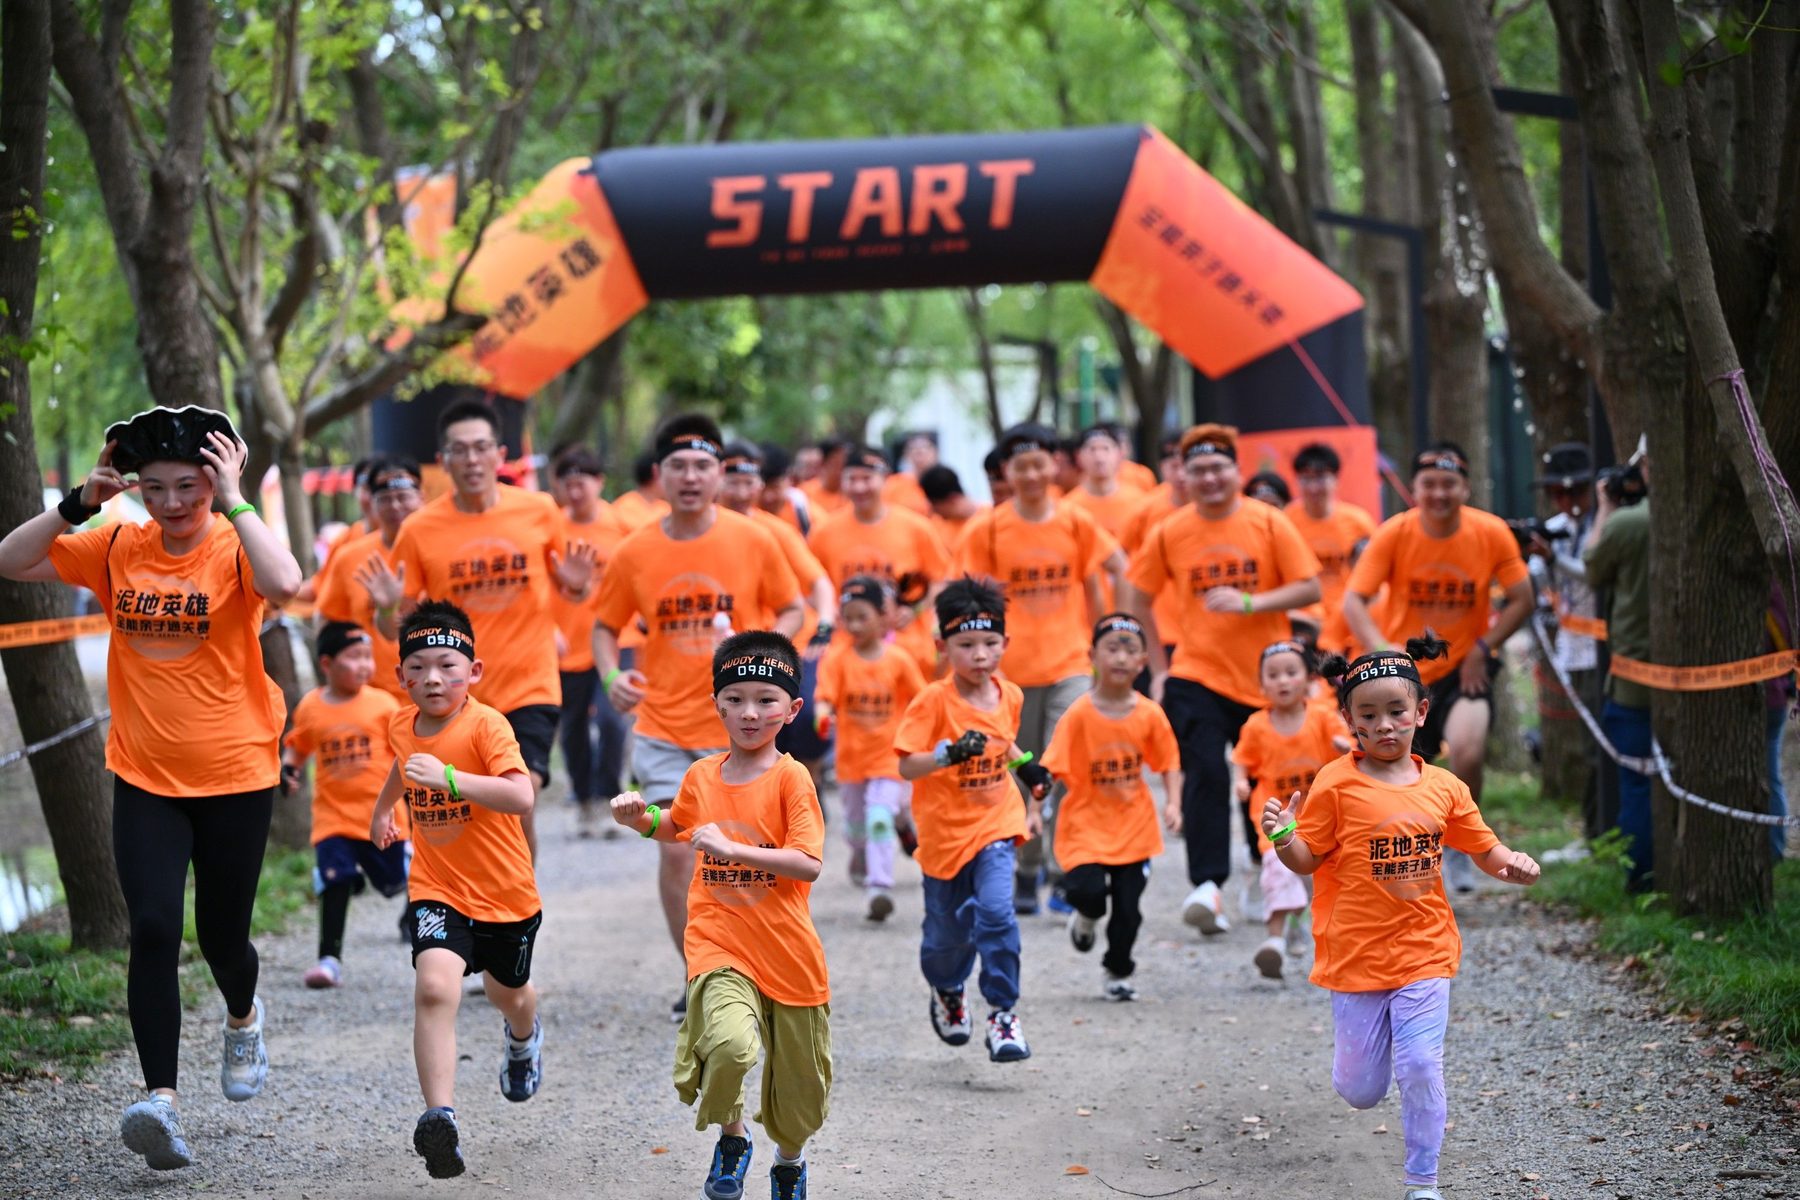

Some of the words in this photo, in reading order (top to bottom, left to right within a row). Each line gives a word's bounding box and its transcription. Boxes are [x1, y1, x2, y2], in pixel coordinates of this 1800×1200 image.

[706, 158, 1035, 249] START
[115, 589, 210, 617] 泥地英雄
[115, 614, 211, 635] 全能亲子通关赛
[406, 627, 442, 642] MUDDY
[427, 634, 461, 648] 0537
[720, 655, 755, 673] MUDDY
[762, 656, 796, 677] HEROS
[738, 664, 774, 677] 0981
[1345, 660, 1374, 682] MUDDY
[1380, 657, 1412, 668] HEROS
[1360, 665, 1398, 681] 0975
